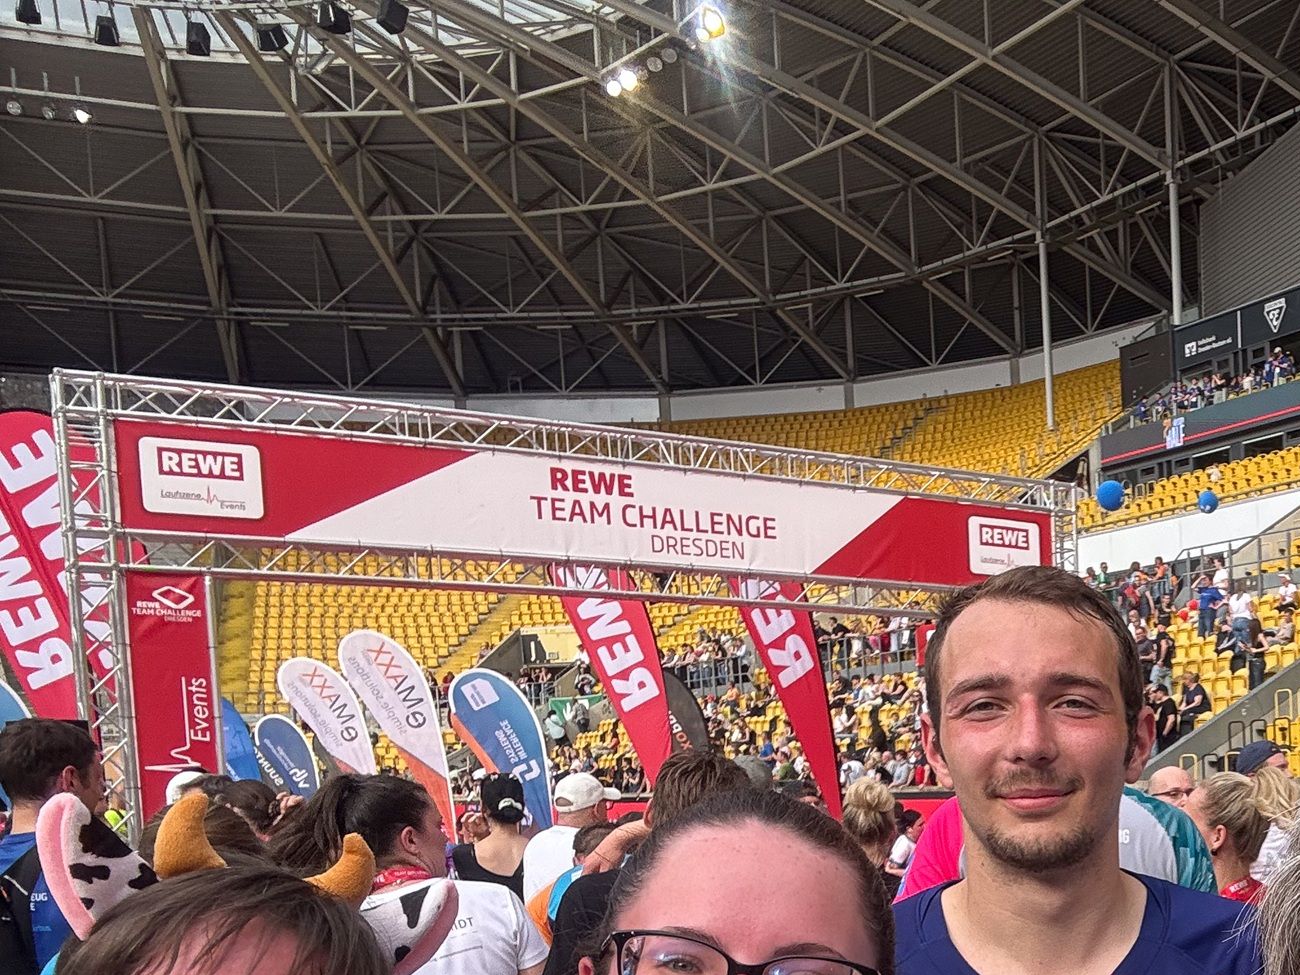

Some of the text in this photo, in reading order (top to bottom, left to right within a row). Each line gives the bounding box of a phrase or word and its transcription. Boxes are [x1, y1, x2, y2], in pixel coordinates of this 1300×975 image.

[161, 451, 241, 477] REWE
[550, 466, 635, 498] REWE
[530, 496, 778, 540] TEAM CHALLENGE
[651, 534, 746, 560] DRESDEN
[981, 527, 1029, 549] REWE
[131, 608, 202, 617] TEAM CHALLENGE
[136, 601, 161, 609] REWE
[187, 677, 211, 742] Events
[452, 917, 473, 931] IDT
